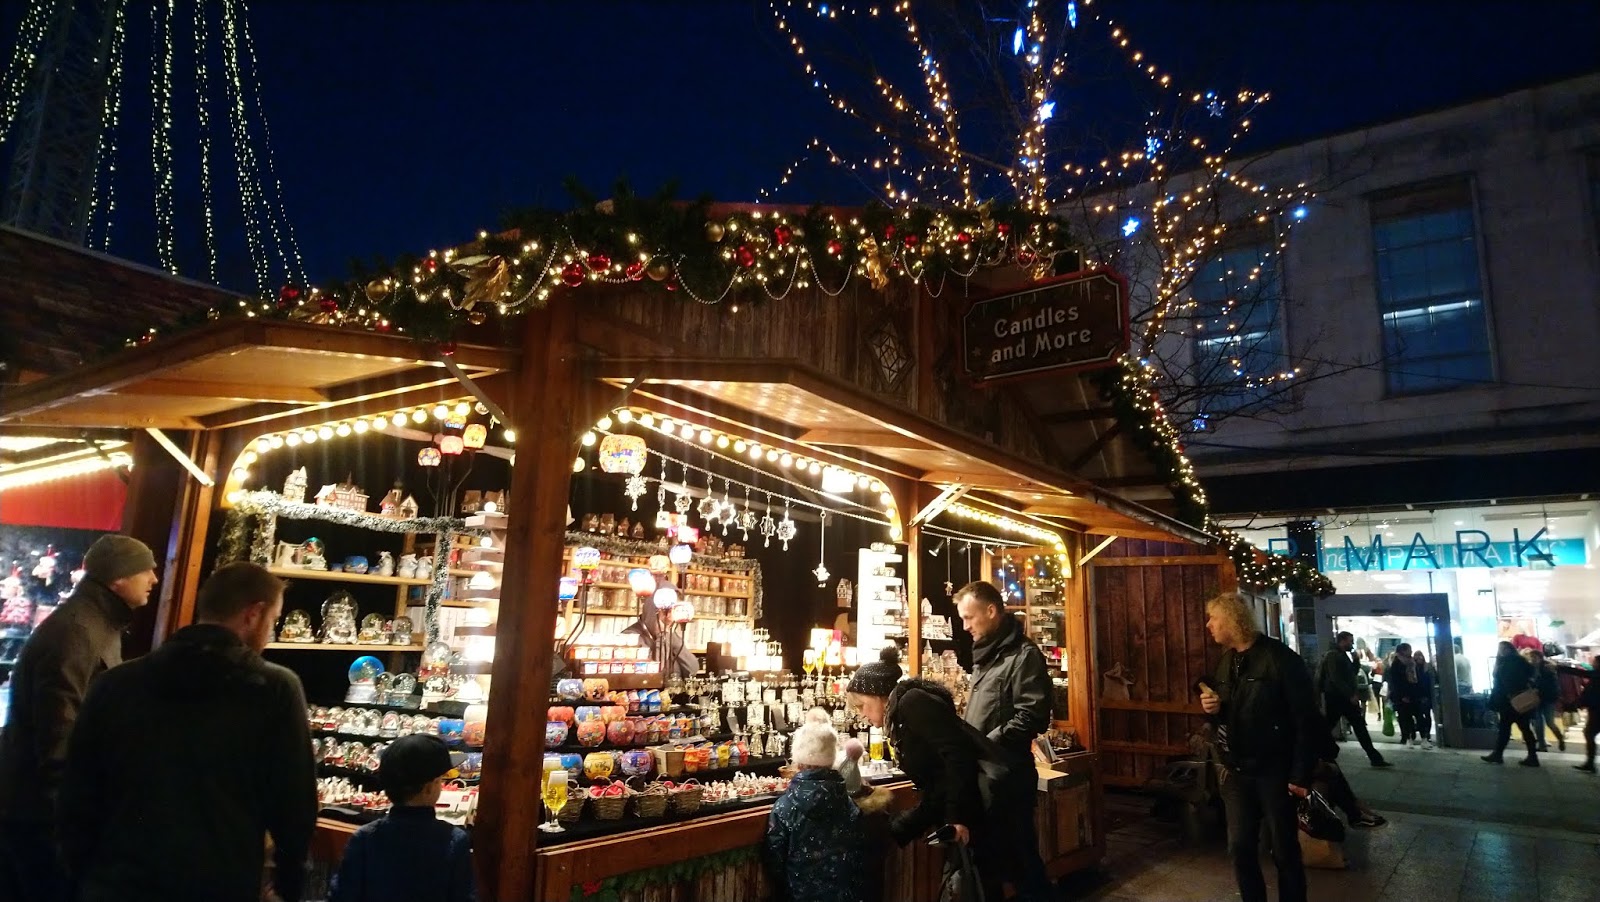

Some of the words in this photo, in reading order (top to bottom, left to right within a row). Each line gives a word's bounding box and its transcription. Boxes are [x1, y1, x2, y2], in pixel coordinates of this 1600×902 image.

[994, 305, 1079, 338] Candles
[991, 337, 1026, 363] and
[1032, 328, 1091, 358] More
